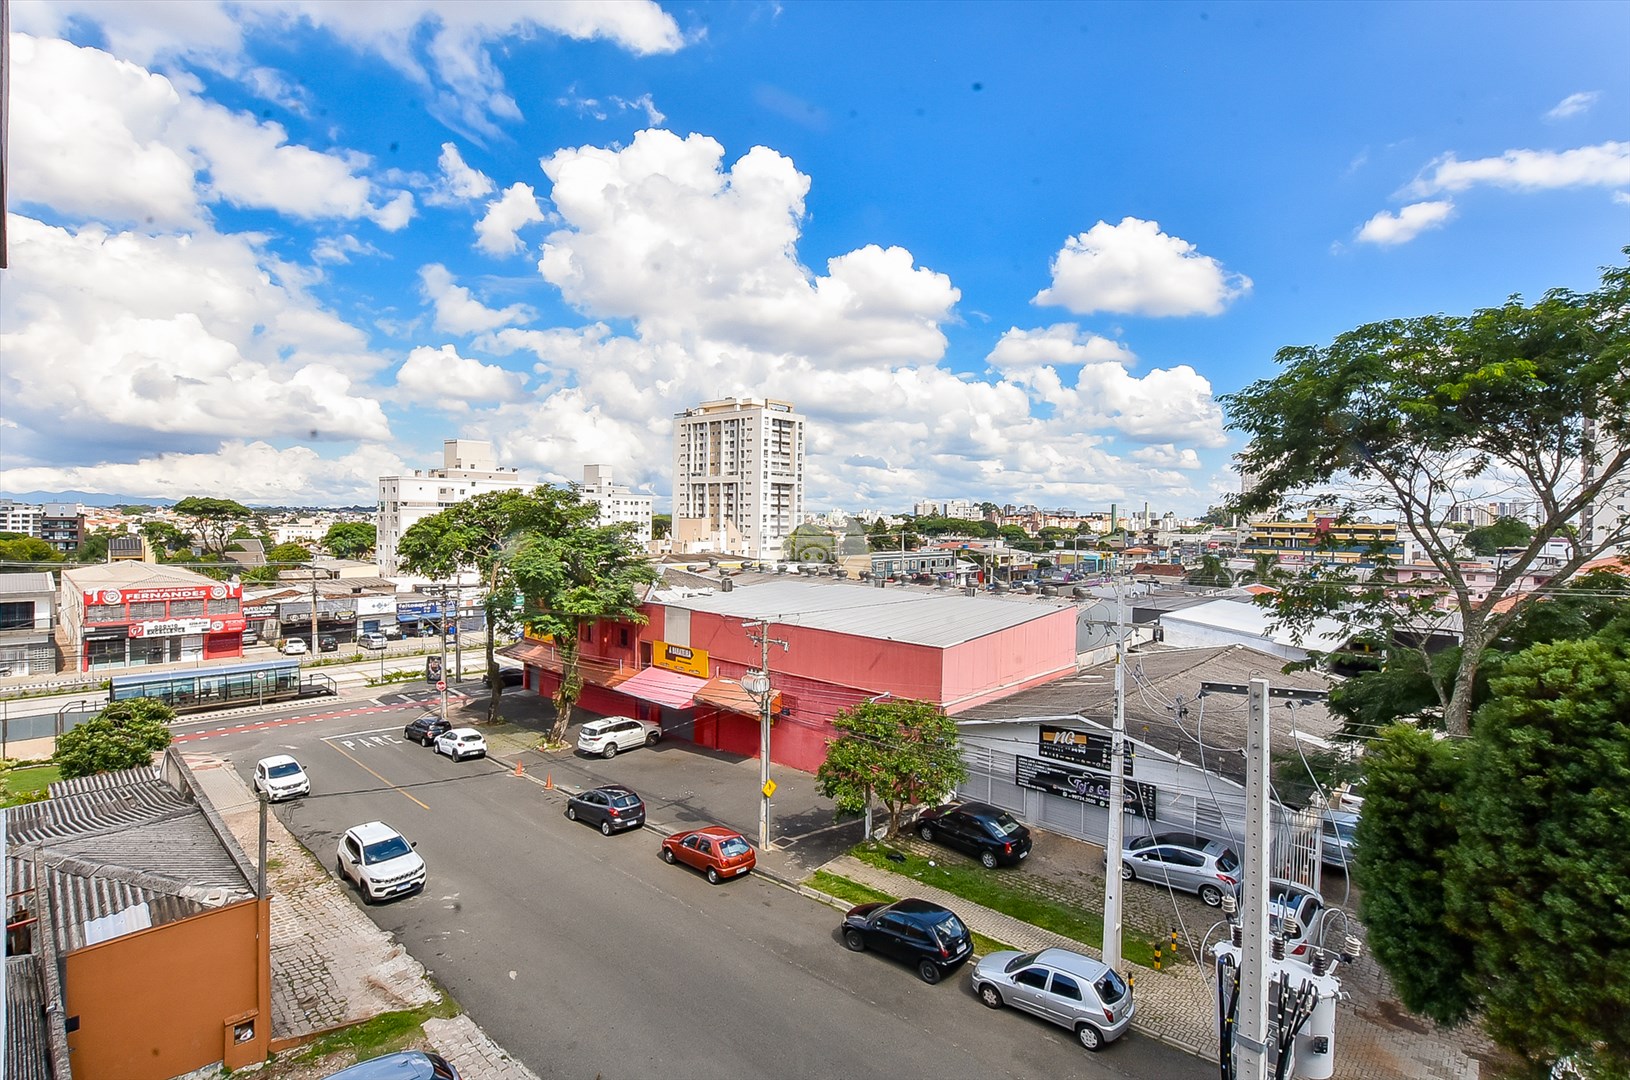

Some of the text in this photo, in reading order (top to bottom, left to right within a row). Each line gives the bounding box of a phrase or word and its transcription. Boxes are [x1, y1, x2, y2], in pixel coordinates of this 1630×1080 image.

[125, 590, 206, 600] FERNANDES
[147, 627, 185, 635] EXCELLENCE
[1053, 731, 1075, 745] NG
